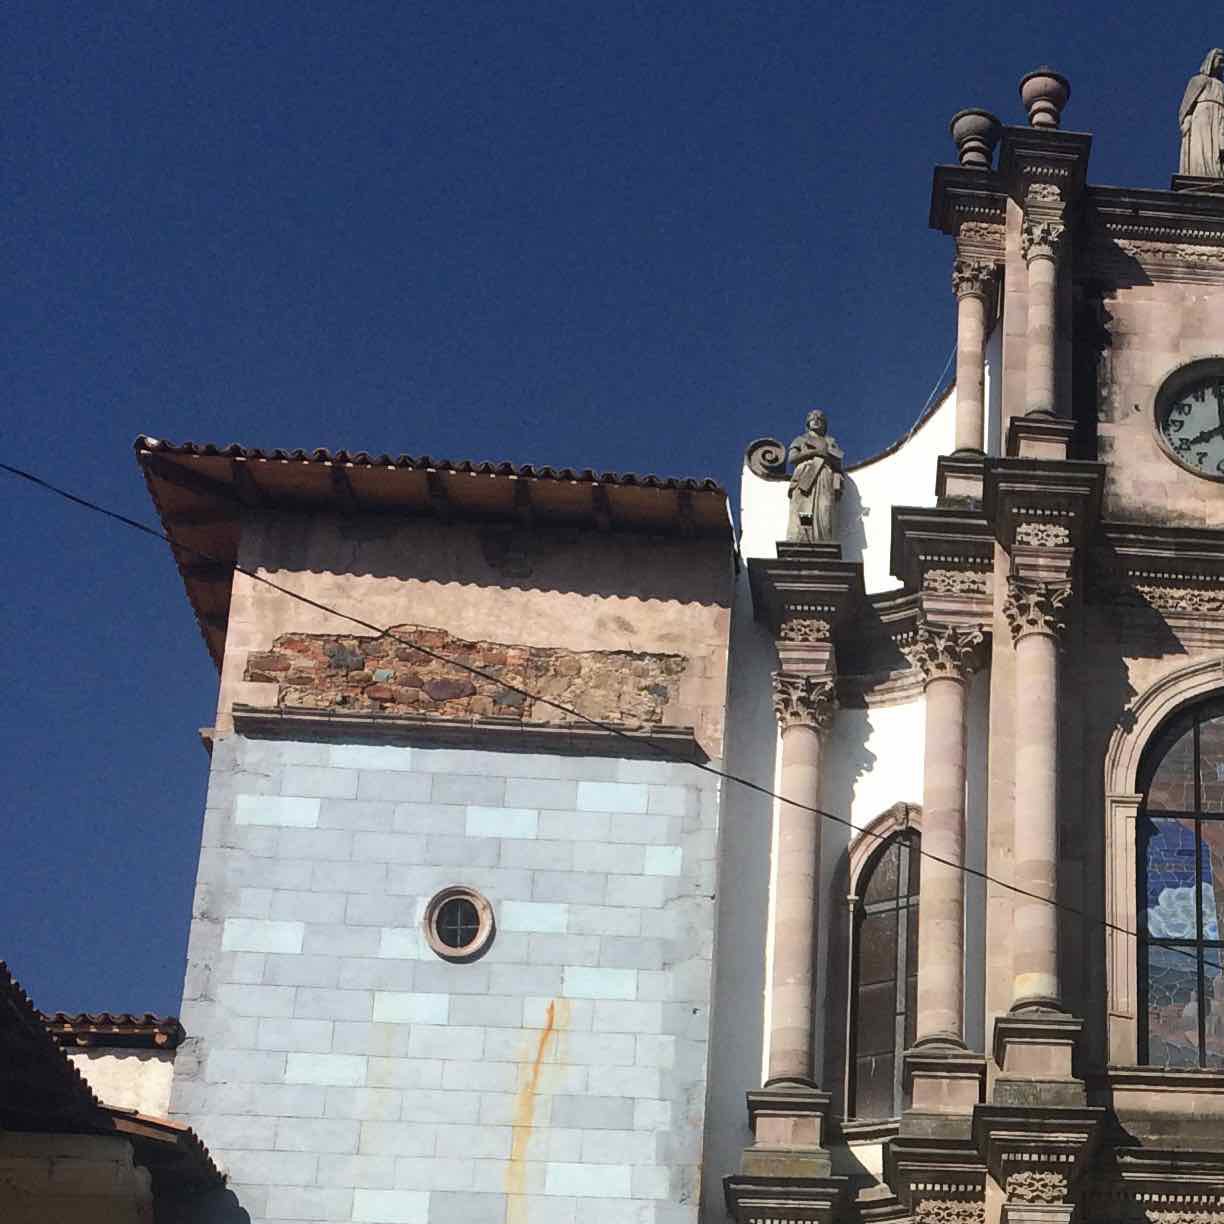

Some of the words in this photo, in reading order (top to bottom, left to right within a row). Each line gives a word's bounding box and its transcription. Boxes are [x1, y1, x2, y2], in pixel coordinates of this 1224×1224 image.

[1170, 419, 1184, 432] 9
[1178, 438, 1191, 451] 8
[1196, 452, 1208, 464] 7
